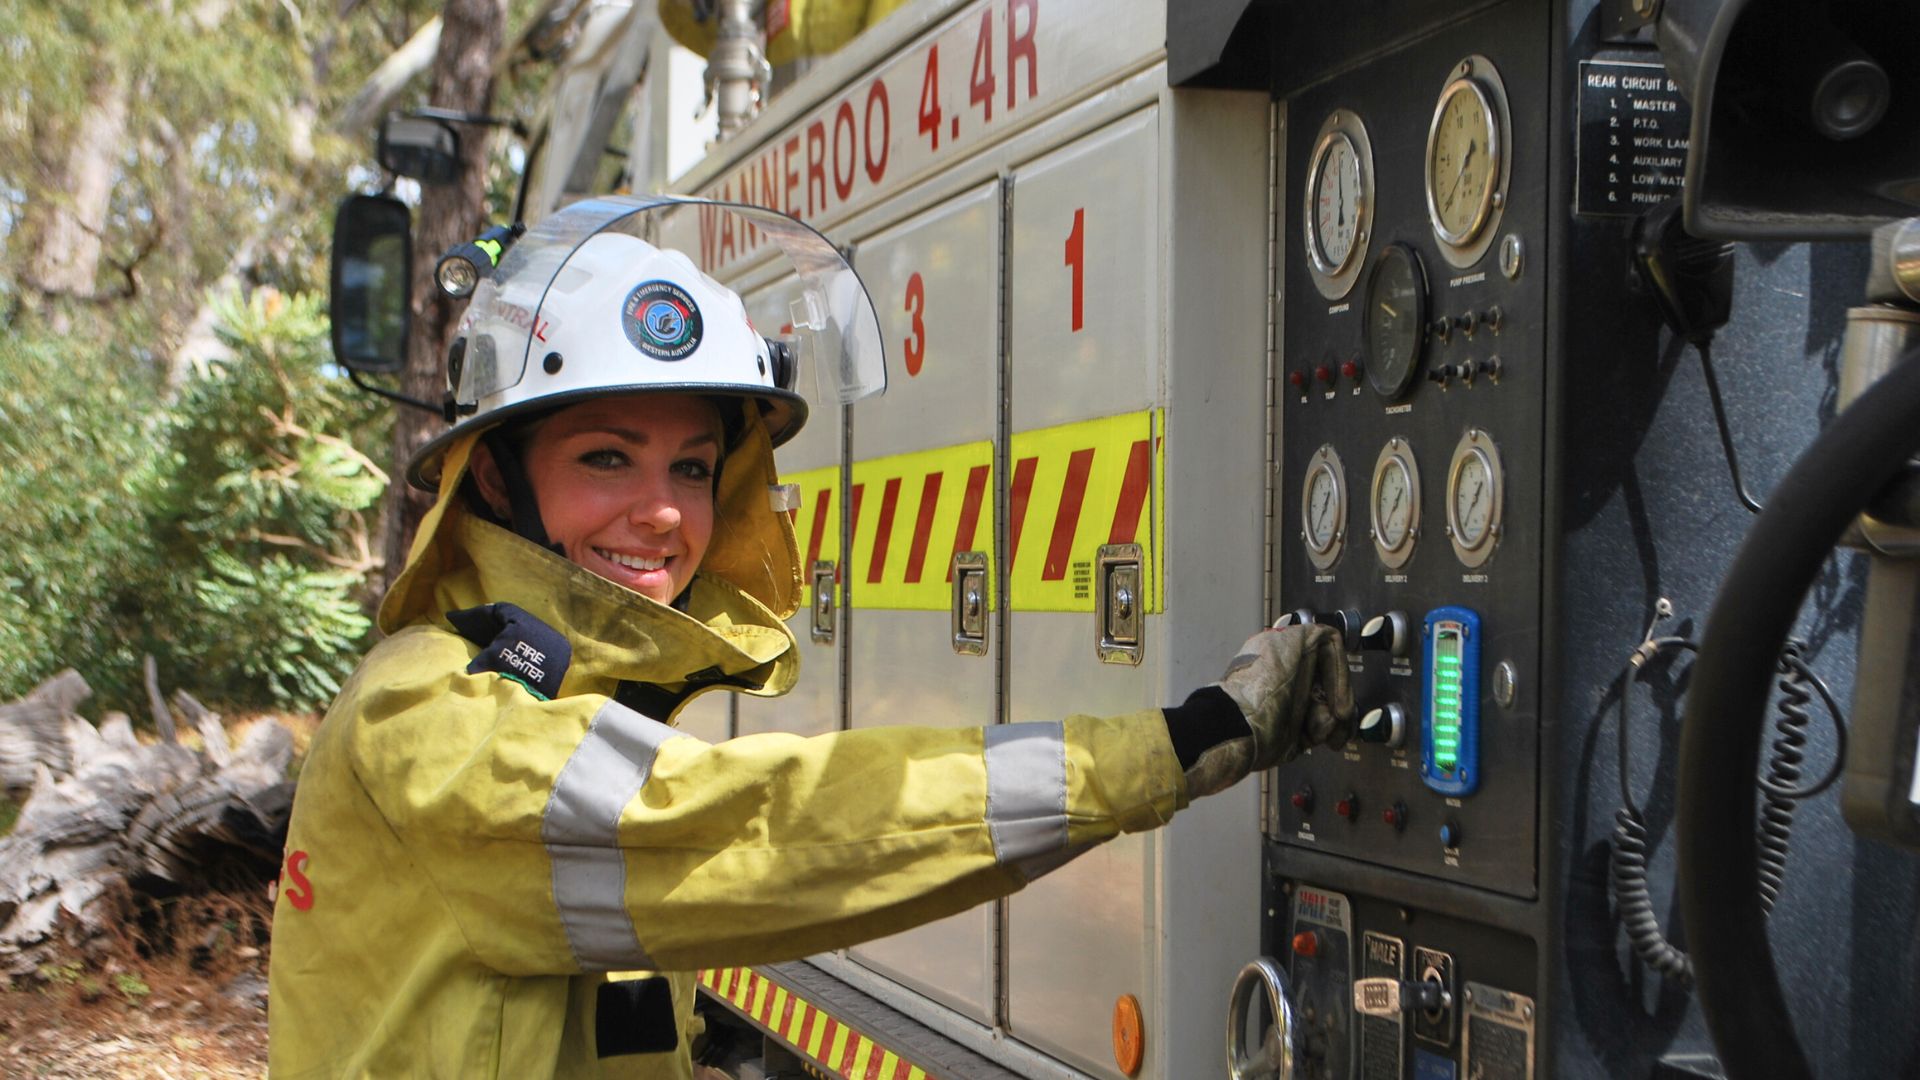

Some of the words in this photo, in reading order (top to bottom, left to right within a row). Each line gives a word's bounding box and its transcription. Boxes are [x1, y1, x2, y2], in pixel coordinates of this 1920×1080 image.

[1588, 74, 1617, 88] REAR
[1622, 76, 1661, 91] CIRCUIT
[1667, 80, 1677, 91] B
[1610, 98, 1617, 109] 1.
[1633, 100, 1676, 112] MASTER
[1610, 116, 1620, 128] 2.
[1633, 119, 1659, 129] P.T.O.
[1610, 135, 1620, 146] 3.
[1634, 137, 1663, 148] WORK
[1609, 154, 1619, 164] 4.
[1633, 156, 1683, 168] AUXILIARY
[699, 77, 890, 273] WANNEROO
[1609, 173, 1618, 183] 5.
[1632, 175, 1655, 185] LOW
[1608, 192, 1617, 202] 6.
[1064, 207, 1085, 333] 1
[637, 284, 672, 298] EMERGENCY
[672, 288, 697, 313] SERVICES
[904, 271, 925, 378] 3
[641, 342, 671, 357] WESTERN
[671, 337, 698, 357] AUSTRALIA
[515, 640, 546, 666] FIRE
[499, 647, 545, 682] FIGHTER
